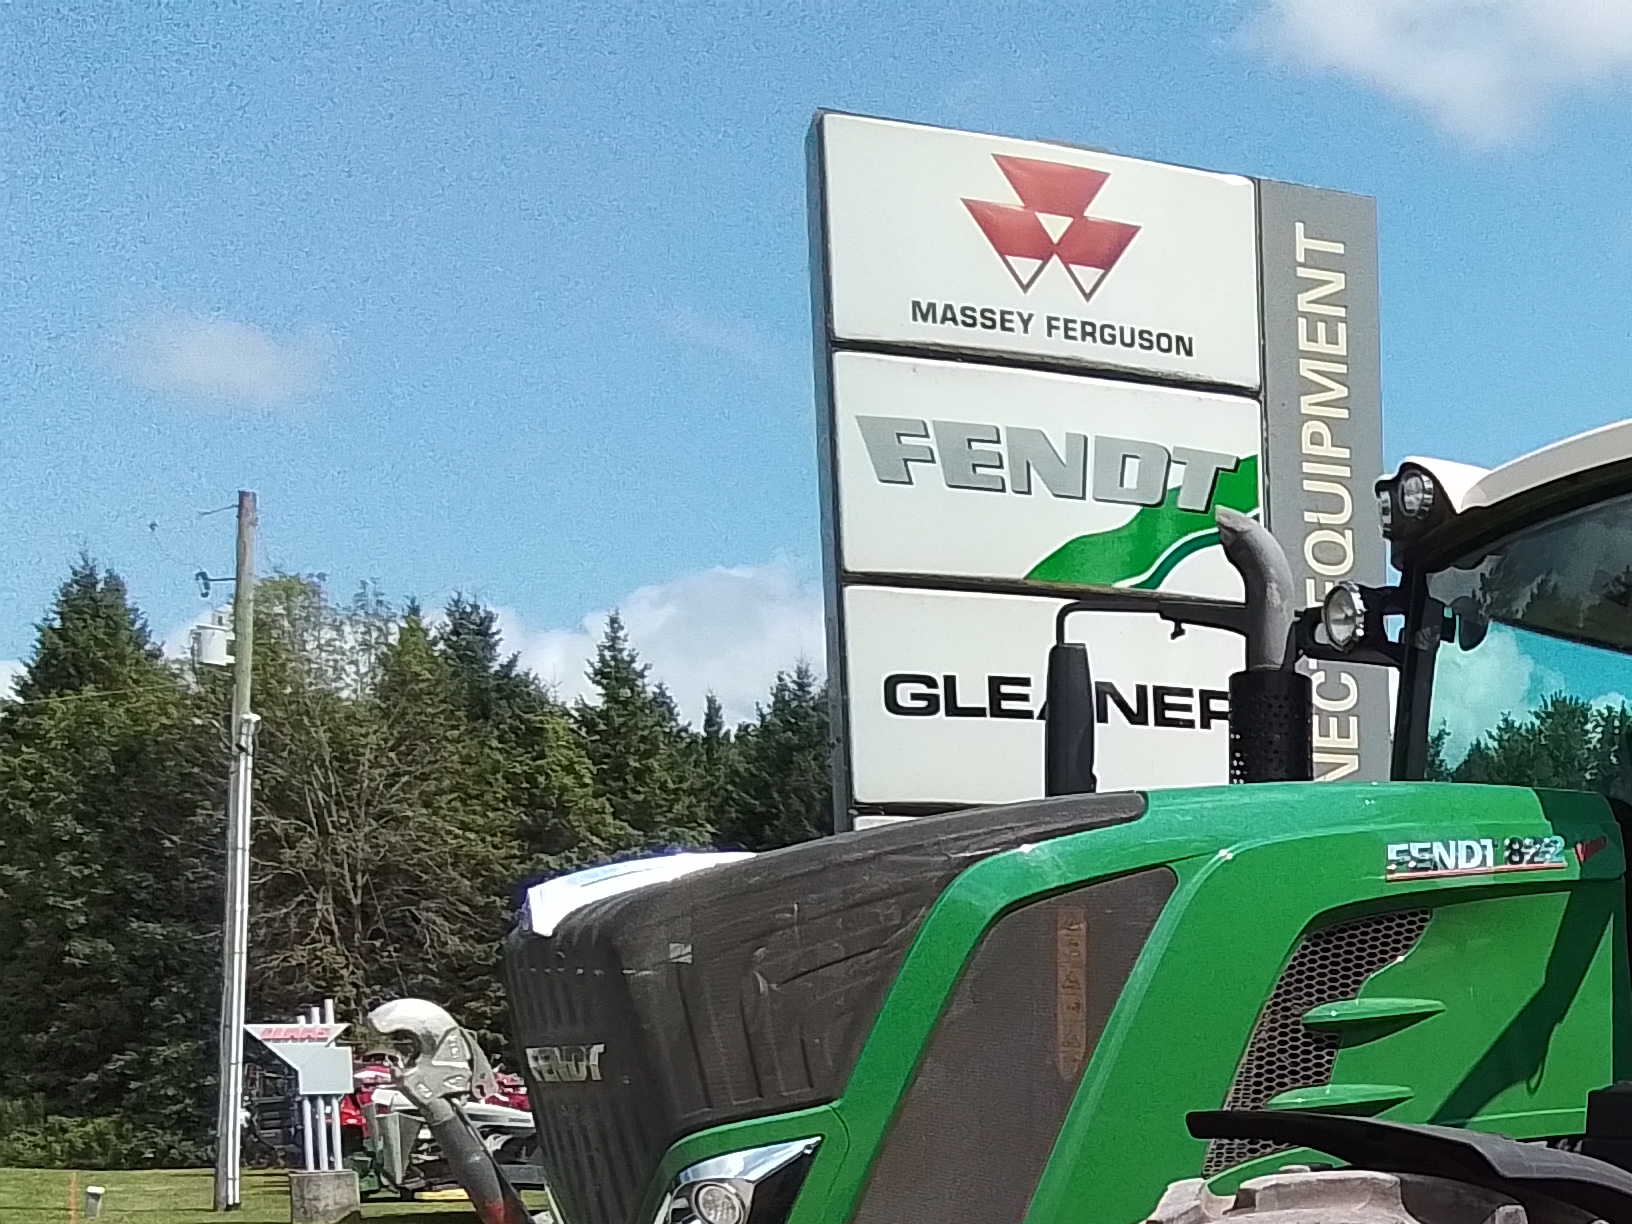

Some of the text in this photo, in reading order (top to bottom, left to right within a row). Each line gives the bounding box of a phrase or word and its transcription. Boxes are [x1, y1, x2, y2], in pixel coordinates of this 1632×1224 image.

[911, 300, 1195, 358] MASSEY FERGUSON
[1294, 222, 1356, 607] EQUIPMENT
[855, 414, 1240, 515] FENDT
[883, 672, 1231, 730] GLENER
[1386, 838, 1495, 873] FENDT
[525, 1043, 606, 1082] FENDT
